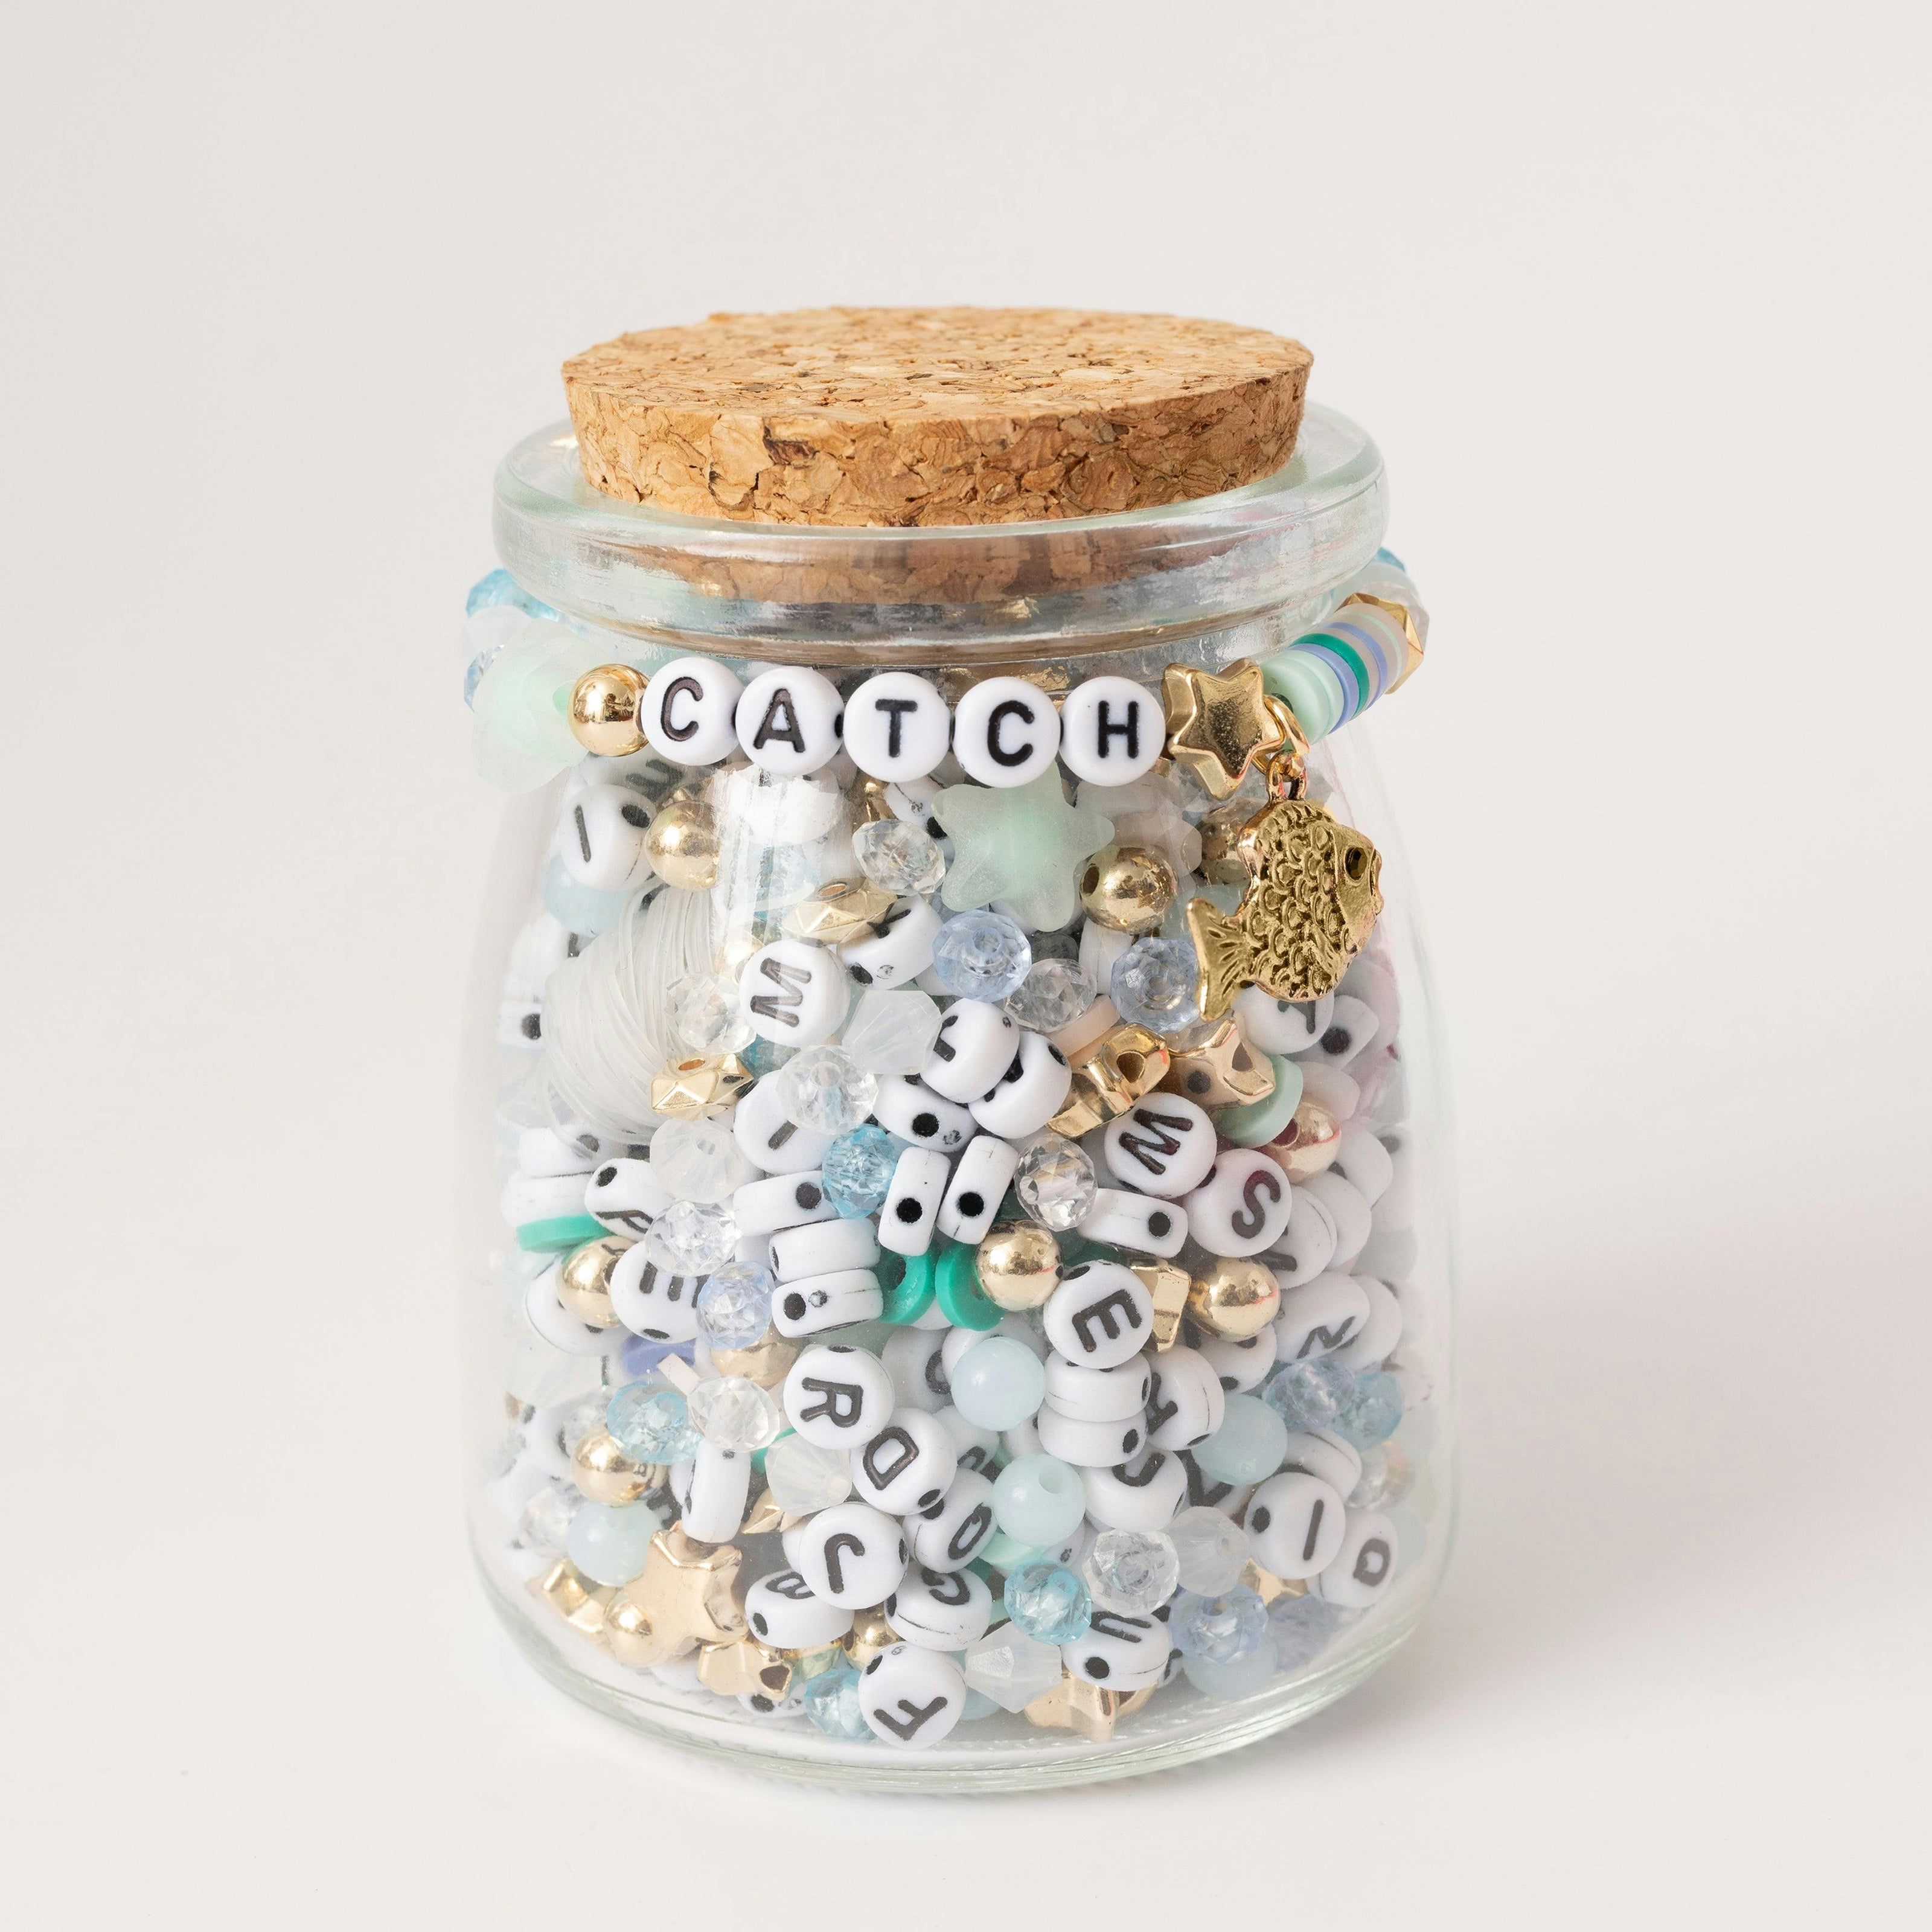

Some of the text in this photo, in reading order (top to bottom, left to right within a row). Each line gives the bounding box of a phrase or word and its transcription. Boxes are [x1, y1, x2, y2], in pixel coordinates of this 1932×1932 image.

[659, 675, 1139, 767] CATCH
[574, 804, 592, 863] I
[1230, 1169, 1281, 1240] S
[1071, 1288, 1143, 1353] E
[799, 1377, 864, 1428] R
[862, 1425, 920, 1491] D
[1302, 1499, 1325, 1561] I
[823, 1532, 866, 1594] J
[873, 1696, 948, 1741] F
